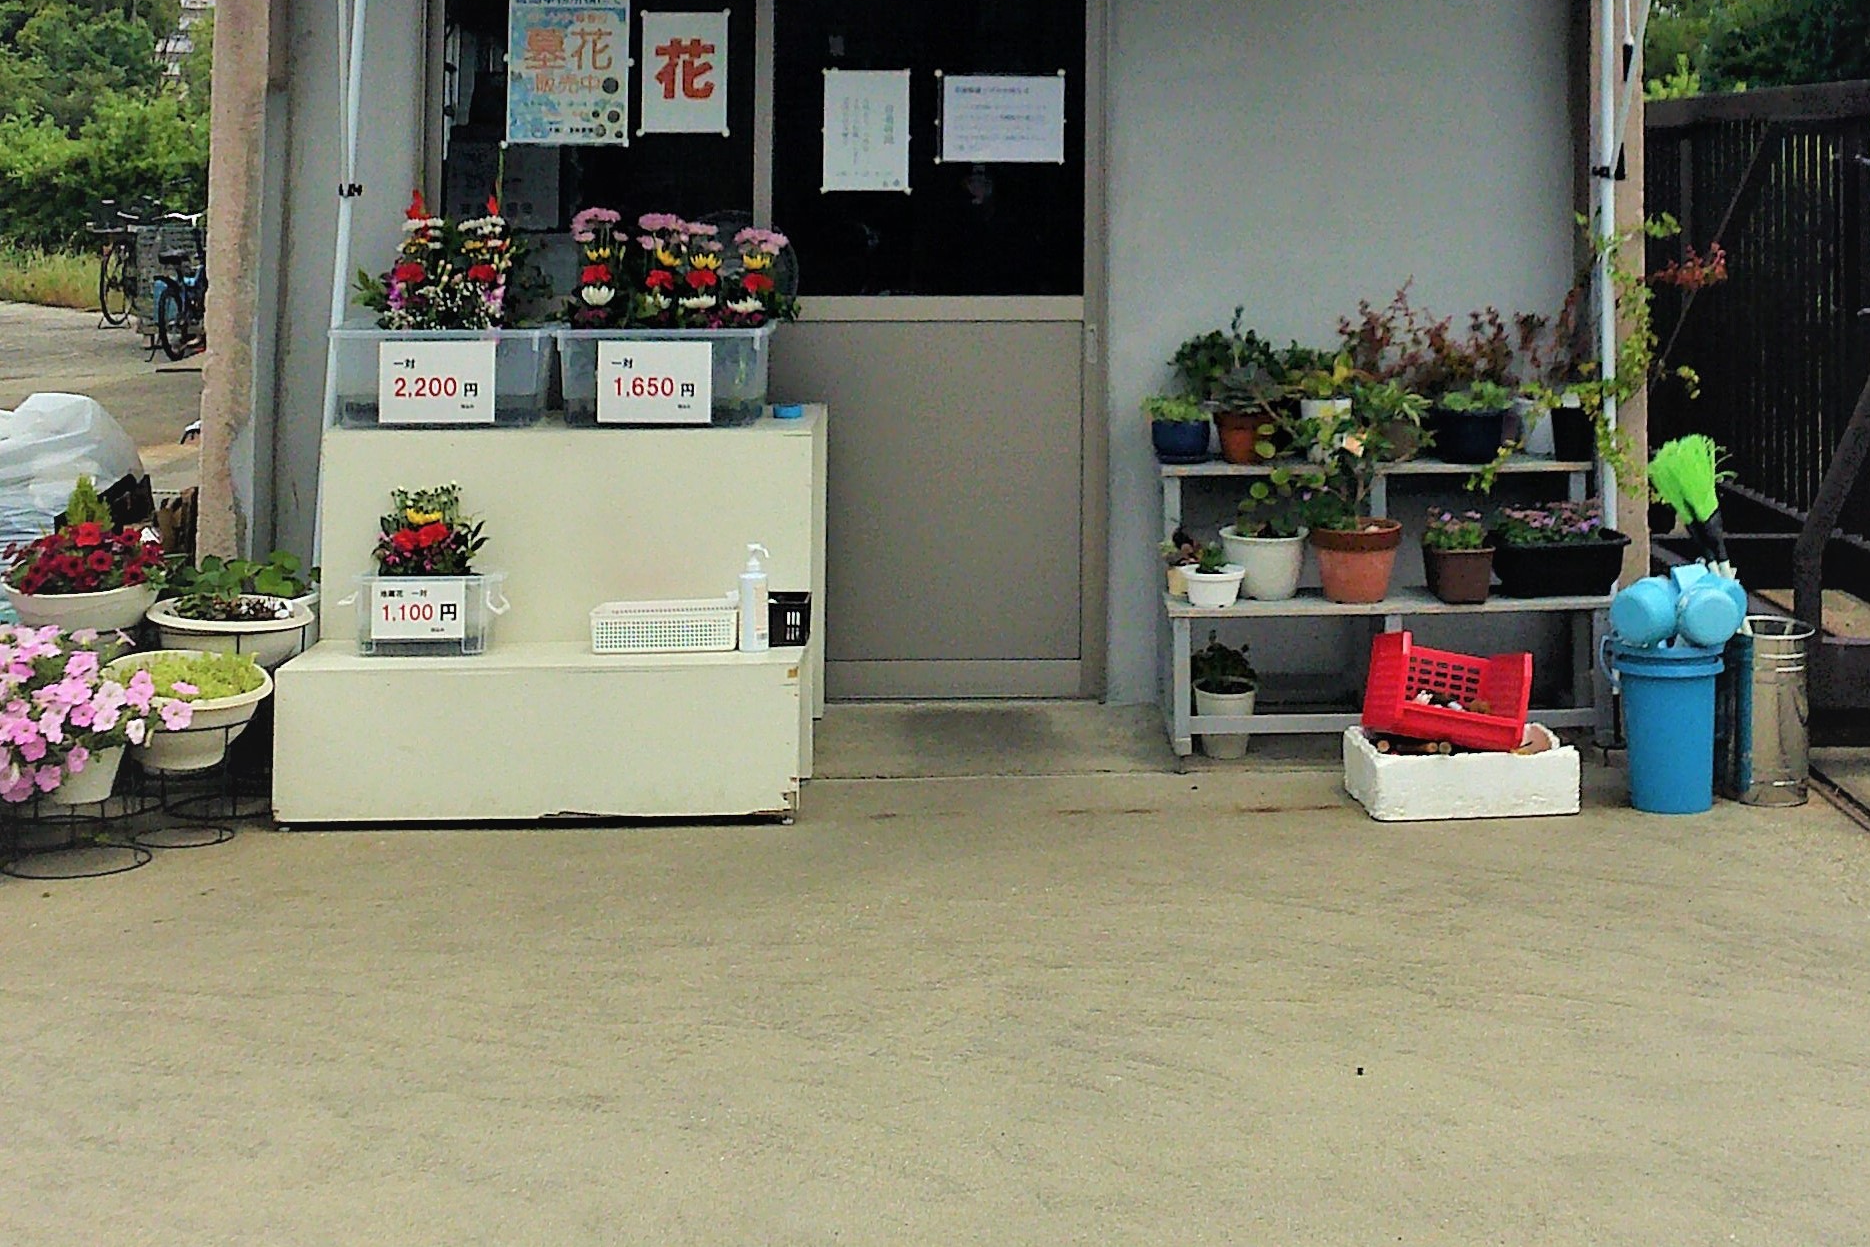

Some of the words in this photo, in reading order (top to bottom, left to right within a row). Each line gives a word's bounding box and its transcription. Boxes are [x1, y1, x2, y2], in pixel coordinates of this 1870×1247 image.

[524, 28, 613, 70] 墓花
[655, 38, 715, 100] 花
[393, 358, 415, 369] 一対
[611, 357, 633, 369] 一対
[394, 377, 457, 398] 2,200
[463, 382, 478, 397] 円
[614, 377, 674, 397] 1,650
[681, 383, 695, 397] 円
[382, 603, 433, 622] 1,100
[440, 603, 457, 621] 円
